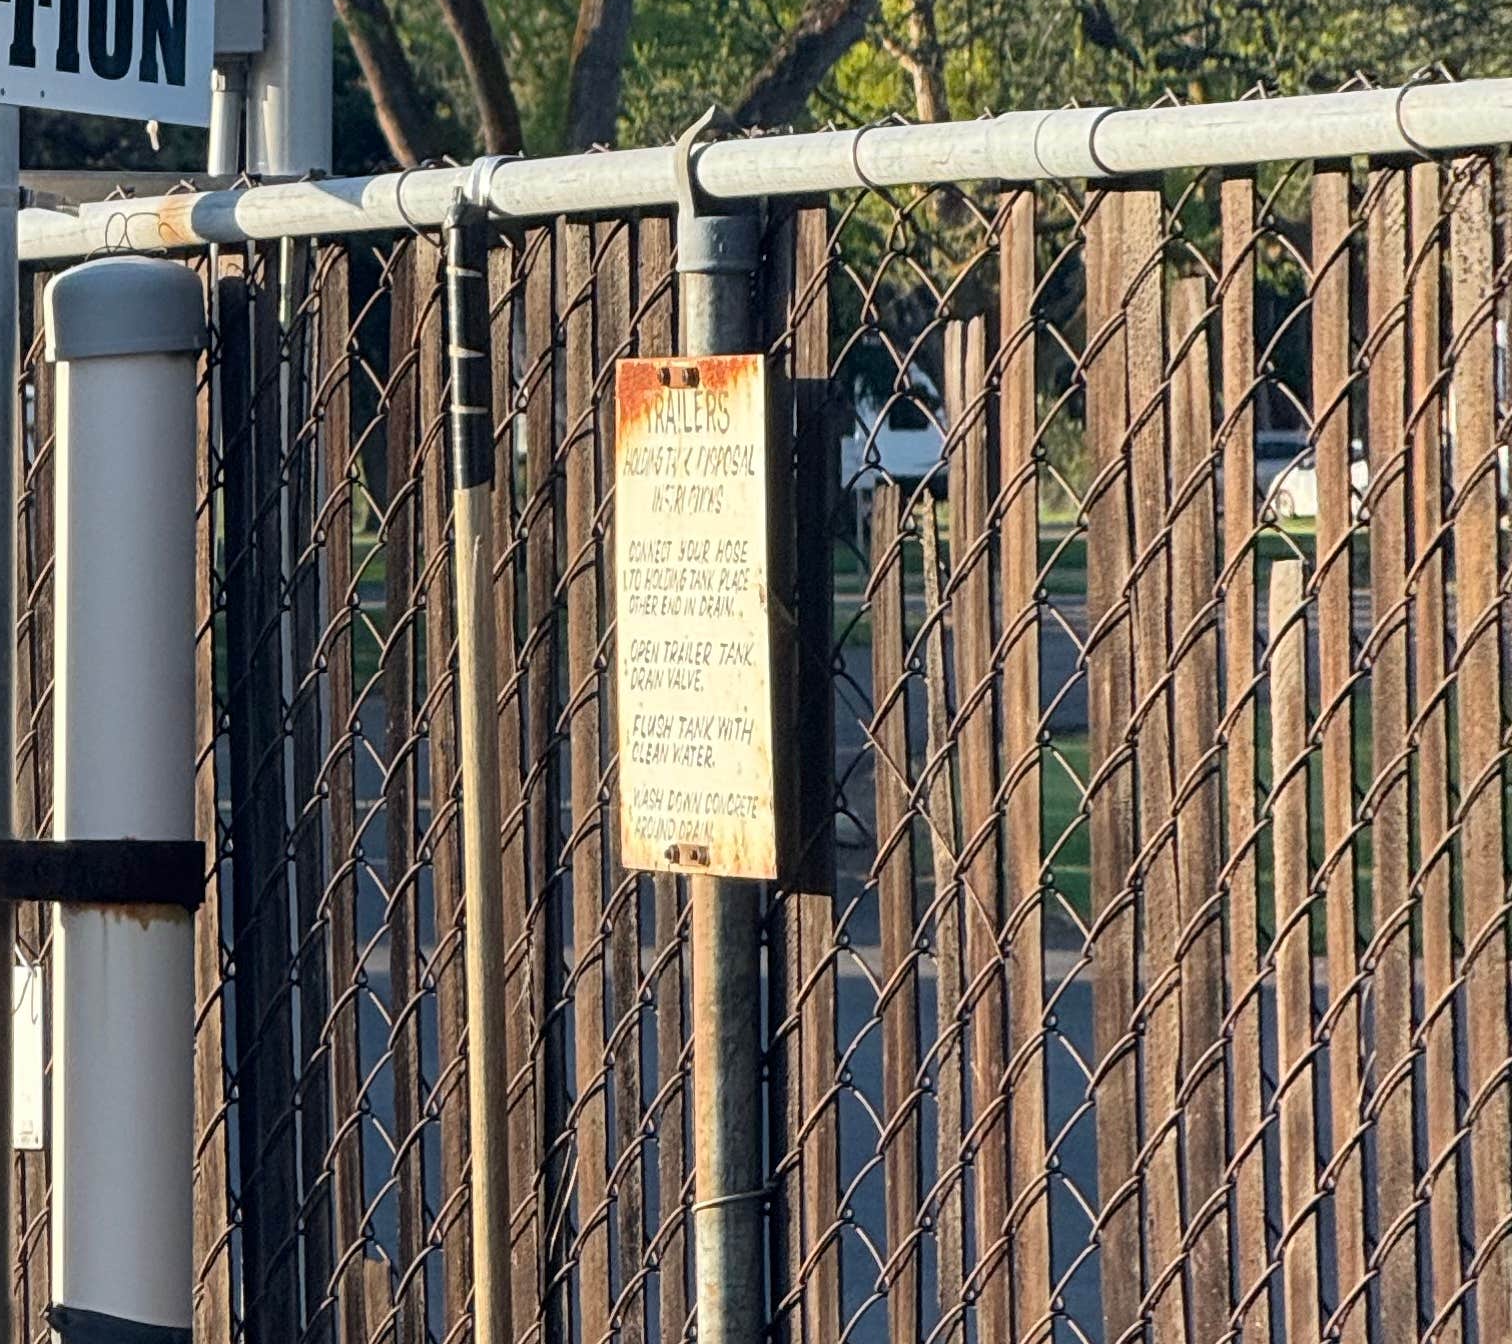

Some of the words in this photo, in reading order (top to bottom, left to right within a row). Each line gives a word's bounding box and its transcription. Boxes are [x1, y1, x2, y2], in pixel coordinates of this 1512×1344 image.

[644, 389, 730, 434] TRAILERS
[629, 539, 672, 564] CONNECT
[678, 539, 711, 564] YOUR
[715, 539, 749, 564] HOSE
[644, 567, 687, 592] HOLDING
[689, 569, 715, 592] TANK
[718, 567, 750, 593] PLACE
[629, 594, 658, 616] OTHER
[661, 596, 682, 616] END
[684, 596, 696, 616] IN
[630, 638, 660, 664] OPEN
[663, 640, 712, 666] TRAILER
[718, 641, 755, 667] TANK
[630, 667, 664, 692] DRAIN
[667, 667, 704, 692] VALVE.
[633, 713, 674, 739] FLUSH
[678, 715, 715, 741] TANK
[717, 716, 755, 745] WITH
[632, 741, 670, 765] CLEAN
[672, 742, 716, 768] WATER.
[633, 787, 664, 811] WASH
[667, 789, 702, 815] DOWN
[704, 792, 759, 819] CONCRETE
